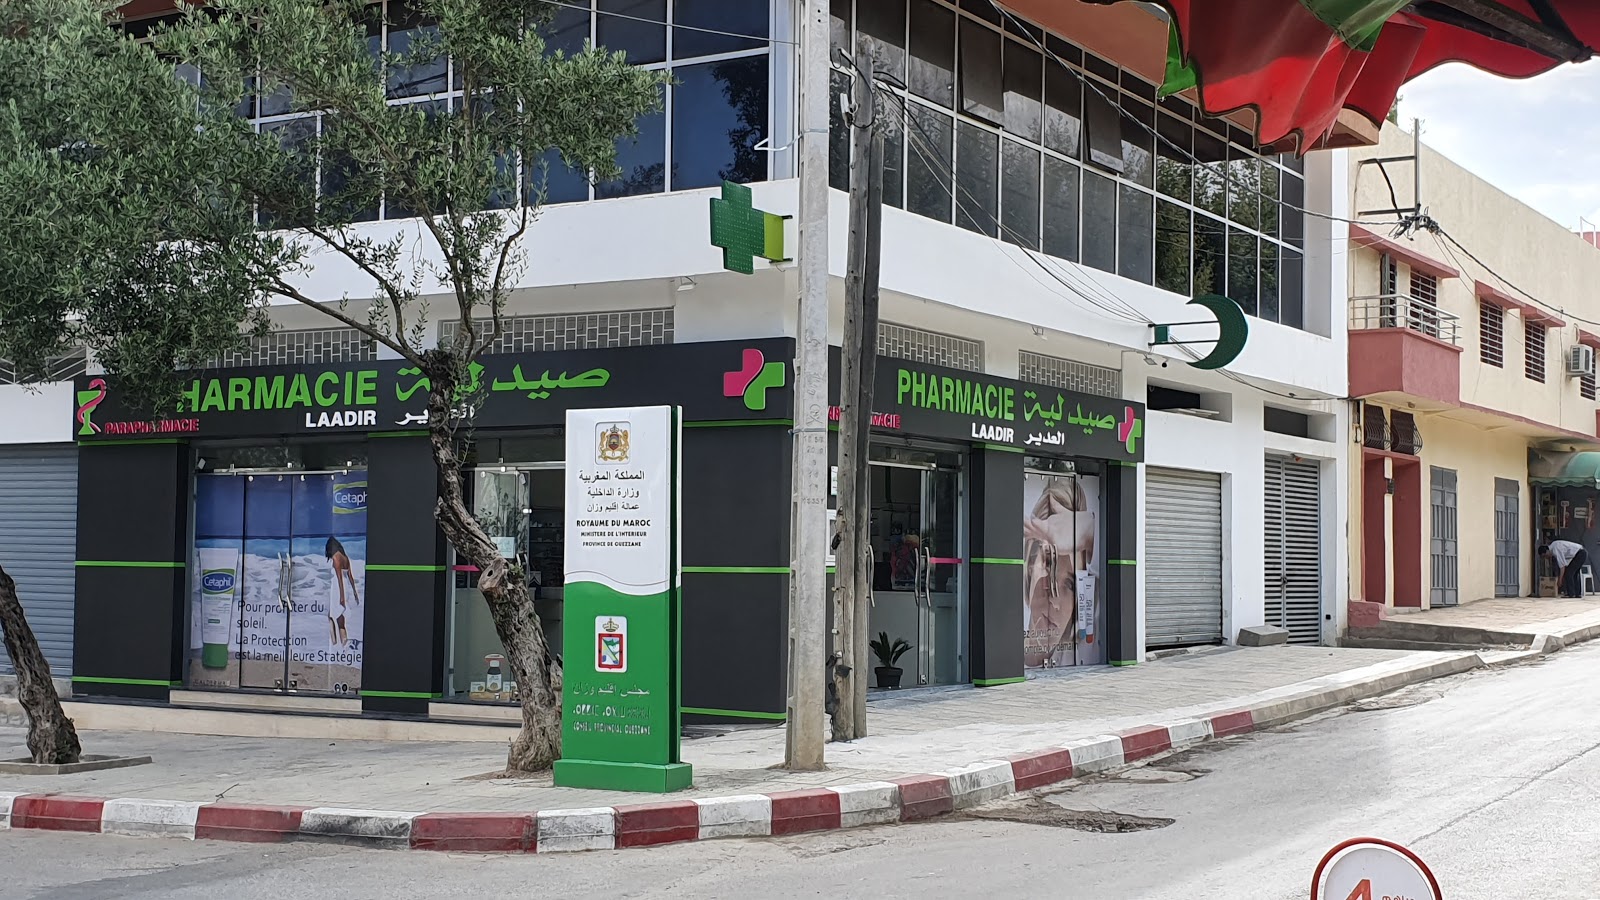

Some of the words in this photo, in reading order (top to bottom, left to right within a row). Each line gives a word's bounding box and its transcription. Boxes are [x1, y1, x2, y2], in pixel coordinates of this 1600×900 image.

[176, 370, 378, 413] HARMACIE
[897, 368, 1015, 421] PHARMACIE
[305, 410, 377, 428] LAADIR
[971, 422, 1014, 443] LAADIR
[578, 470, 611, 483] المغربية
[614, 469, 645, 480] المملكة
[334, 491, 368, 506] Cetaph
[587, 486, 615, 499] الداخلية
[617, 487, 640, 499] وزارة
[586, 503, 603, 513] وزان
[621, 501, 640, 510] عمالة
[576, 519, 609, 527] ROYAUME
[611, 519, 621, 527] DU
[622, 519, 651, 527] MAROC
[203, 576, 232, 588] Cetaphil
[237, 600, 262, 613] Pour
[310, 600, 324, 612] du
[236, 616, 267, 629] soleil.
[235, 633, 249, 645] La
[251, 633, 307, 647] Protection
[234, 650, 250, 661] est
